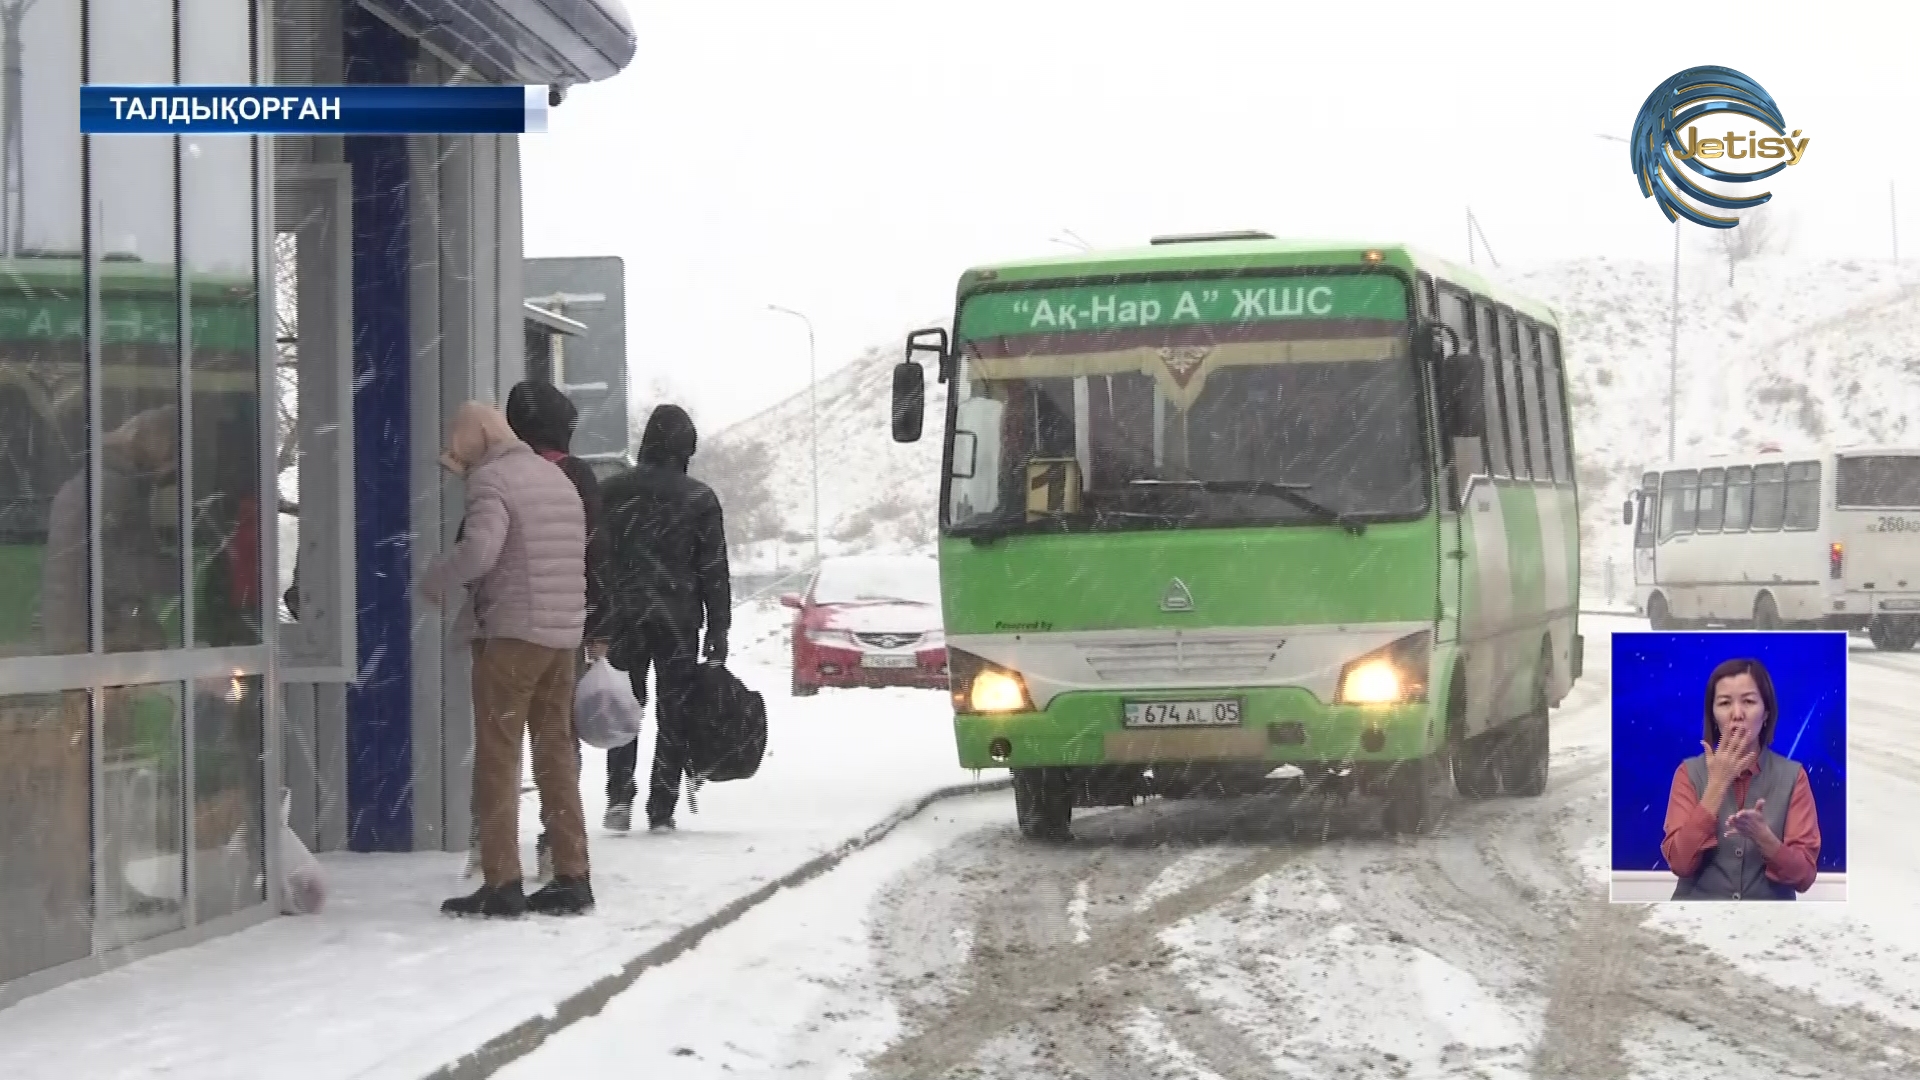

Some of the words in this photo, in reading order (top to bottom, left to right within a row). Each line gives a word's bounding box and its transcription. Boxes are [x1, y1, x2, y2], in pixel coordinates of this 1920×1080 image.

[1231, 285, 1333, 318] ЖШС
[1144, 704, 1181, 723] 674
[1186, 707, 1207, 722] AL
[1214, 703, 1239, 721] 05
